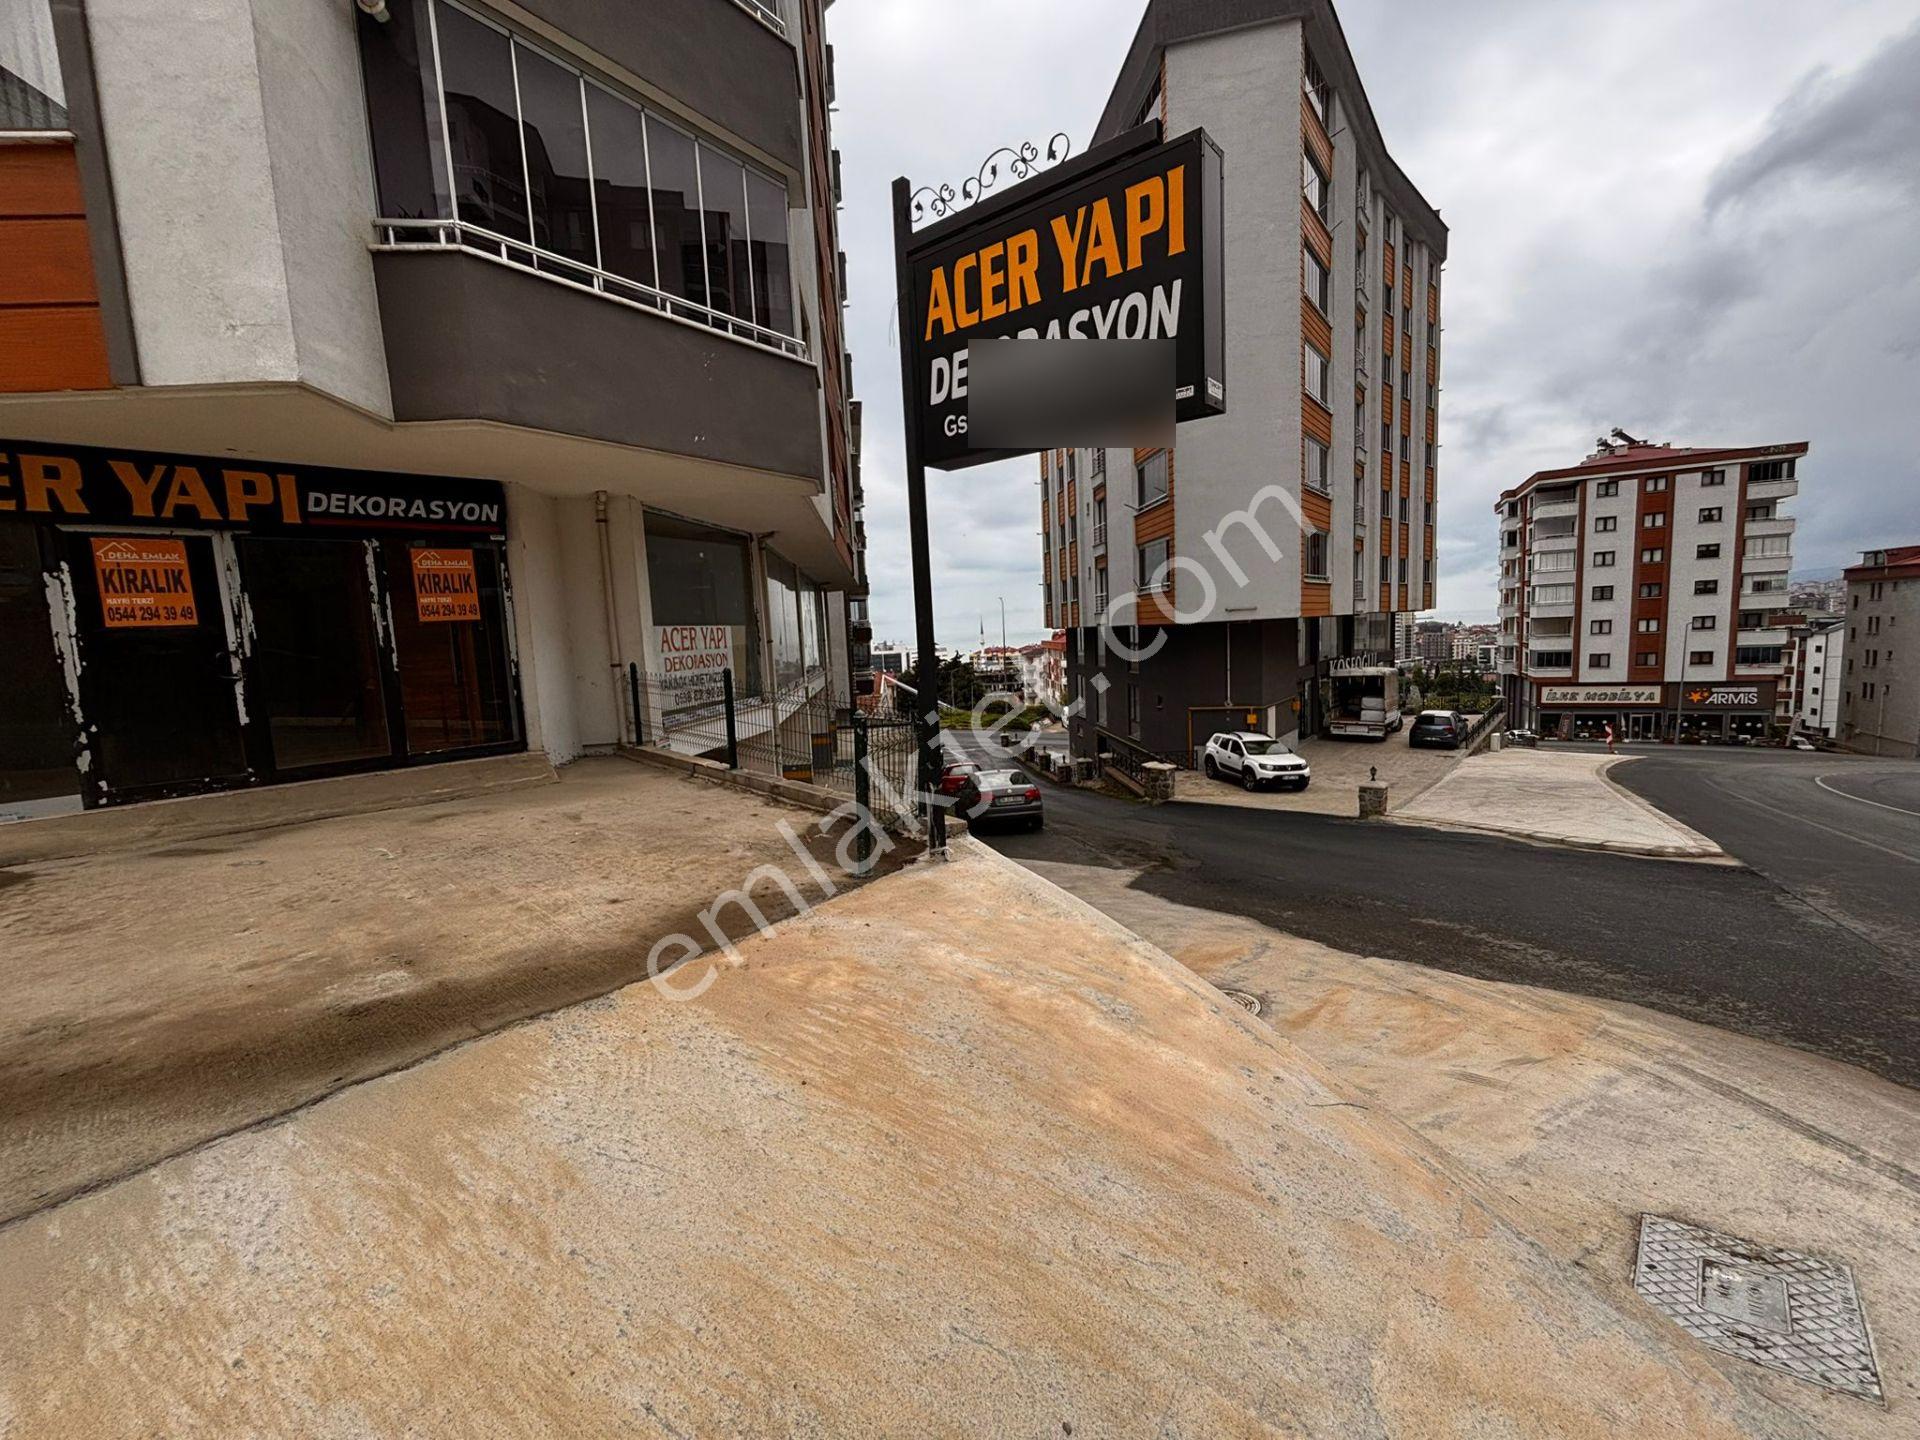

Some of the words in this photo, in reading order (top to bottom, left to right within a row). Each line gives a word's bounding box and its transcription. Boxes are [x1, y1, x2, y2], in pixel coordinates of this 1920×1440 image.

[925, 228, 1042, 341] ACER
[1050, 164, 1186, 293] YAPI
[107, 460, 302, 524] YAPI
[307, 491, 499, 522] DEKORASYON
[108, 552, 139, 560] DEHA
[142, 552, 180, 560] EMLAK
[101, 562, 188, 594] KİRALIK
[417, 568, 474, 593] KİRALIK
[108, 607, 137, 621] 0544
[140, 607, 161, 620] 294
[163, 606, 177, 620] 39
[181, 606, 194, 619] 49
[661, 627, 697, 652] ACER
[700, 627, 728, 649] YAPI
[1583, 688, 1656, 701] MOBİLYA
